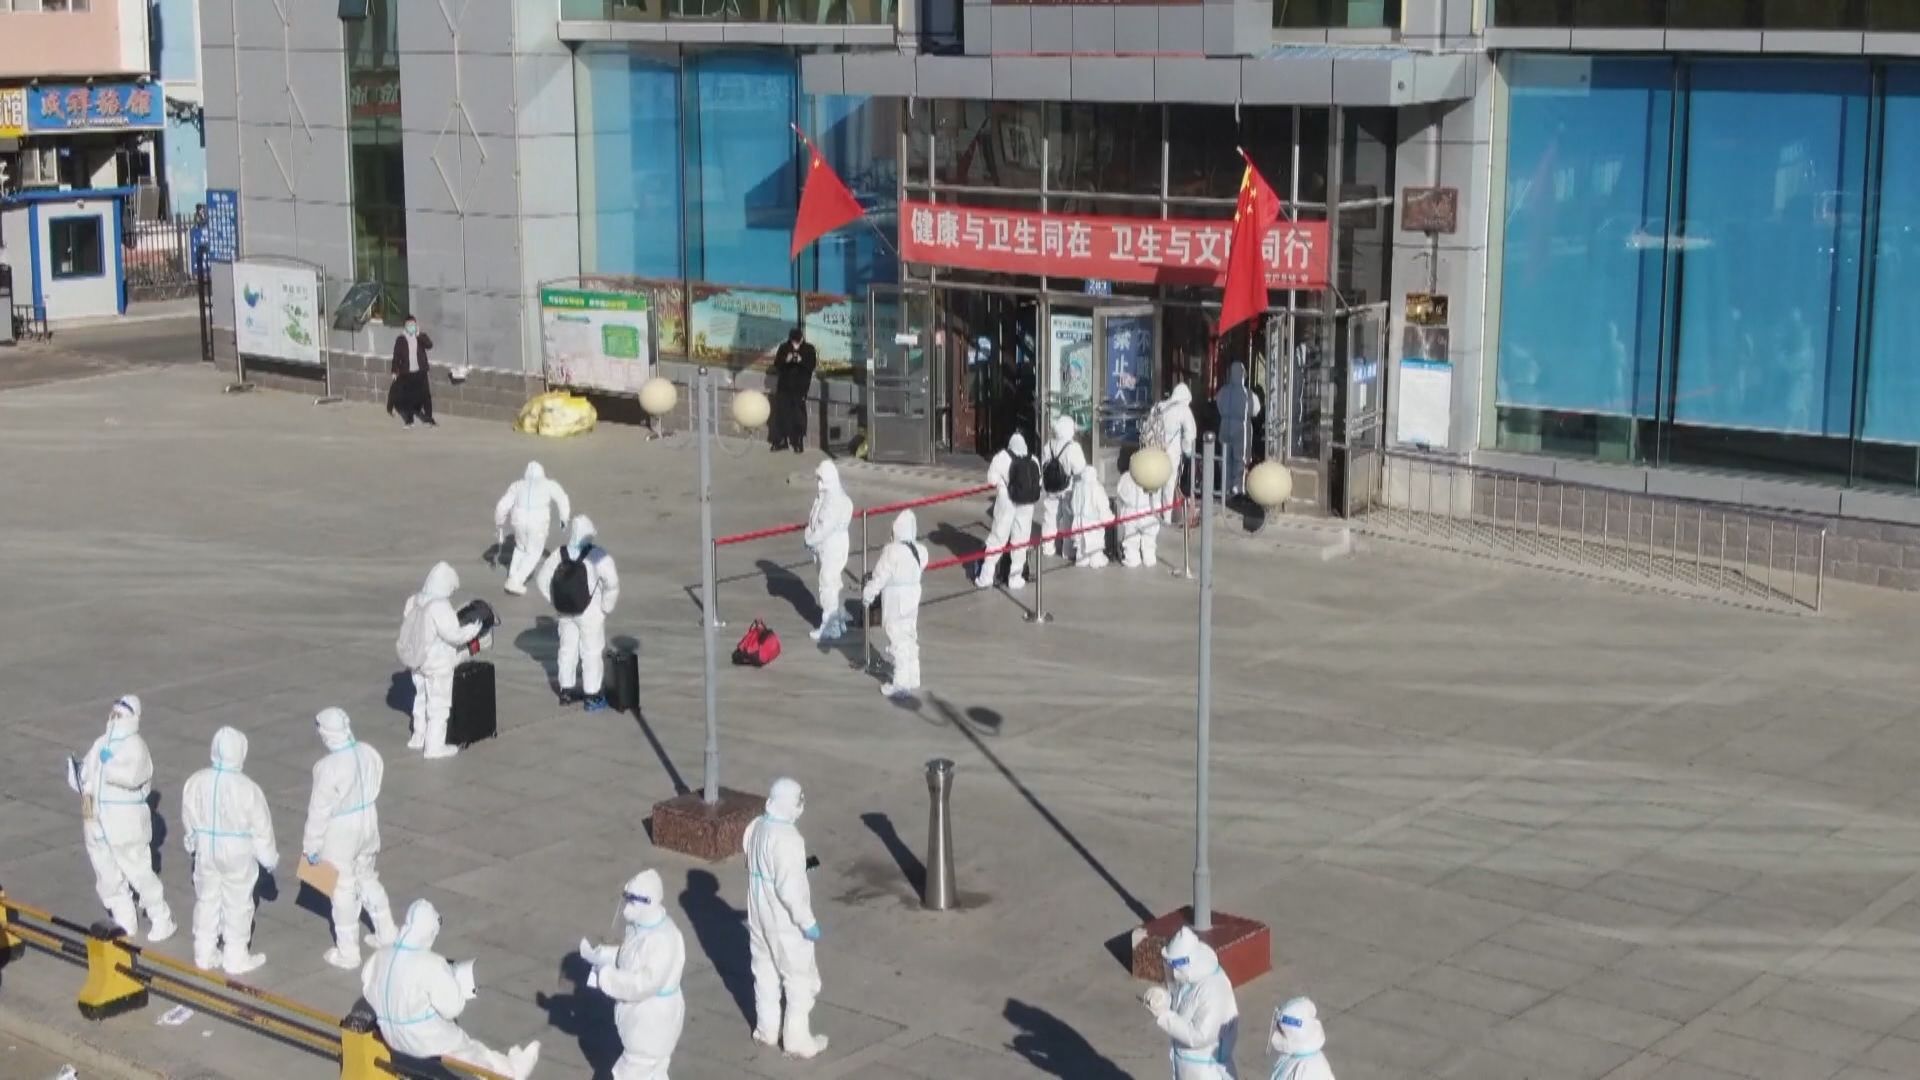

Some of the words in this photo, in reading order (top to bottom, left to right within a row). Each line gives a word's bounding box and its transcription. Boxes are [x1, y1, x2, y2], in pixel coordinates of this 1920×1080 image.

[911, 207, 1092, 258] 健康与卫生同在
[1109, 224, 1313, 269] 卫生与文同行
